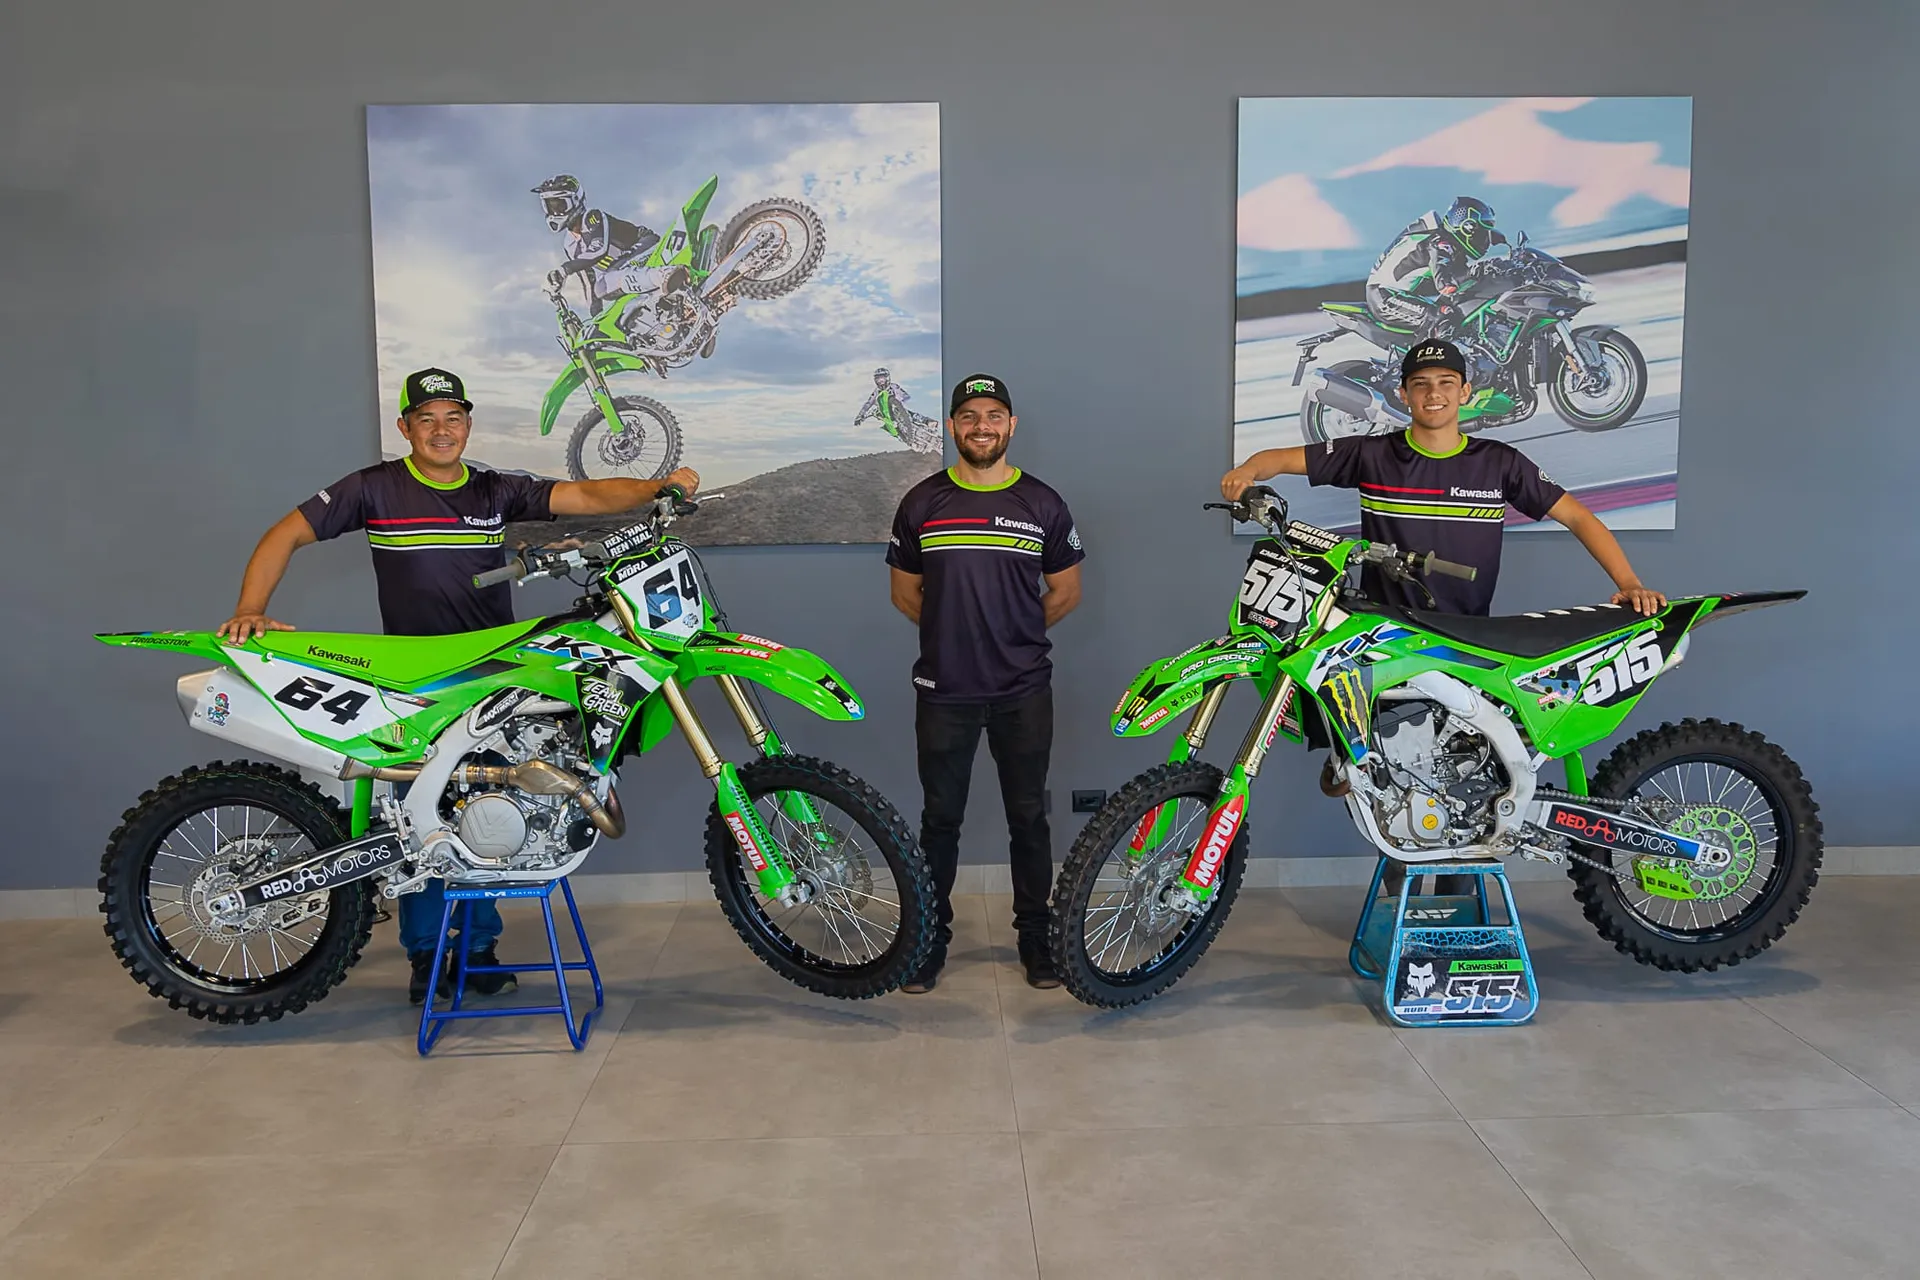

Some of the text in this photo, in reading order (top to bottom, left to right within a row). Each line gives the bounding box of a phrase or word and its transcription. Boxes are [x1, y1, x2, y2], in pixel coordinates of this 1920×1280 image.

[1417, 347, 1444, 358] FOX
[1286, 528, 1336, 549] RENTHAL
[1291, 521, 1342, 543] RENTHAL
[616, 561, 649, 581] MORA
[643, 559, 700, 630] 64
[1239, 559, 1326, 623] 515
[307, 645, 372, 669] Kawasaki
[541, 633, 640, 673] KX
[1315, 624, 1386, 670] KX
[1181, 654, 1259, 679] PRO CIRCUIT
[1577, 630, 1664, 704] 515
[274, 676, 371, 725] 64
[583, 677, 622, 703] TEAM
[583, 694, 628, 717] GREEN
[1180, 688, 1199, 702] FOX
[1139, 708, 1169, 730] MOTUL
[727, 816, 765, 870] MOTUL
[1194, 809, 1240, 886] MOTUL
[1556, 811, 1677, 855] RED MOTORS
[261, 845, 391, 899] RED MOTORS
[1458, 962, 1508, 971] Kawasaki
[1442, 975, 1520, 1014] 515
